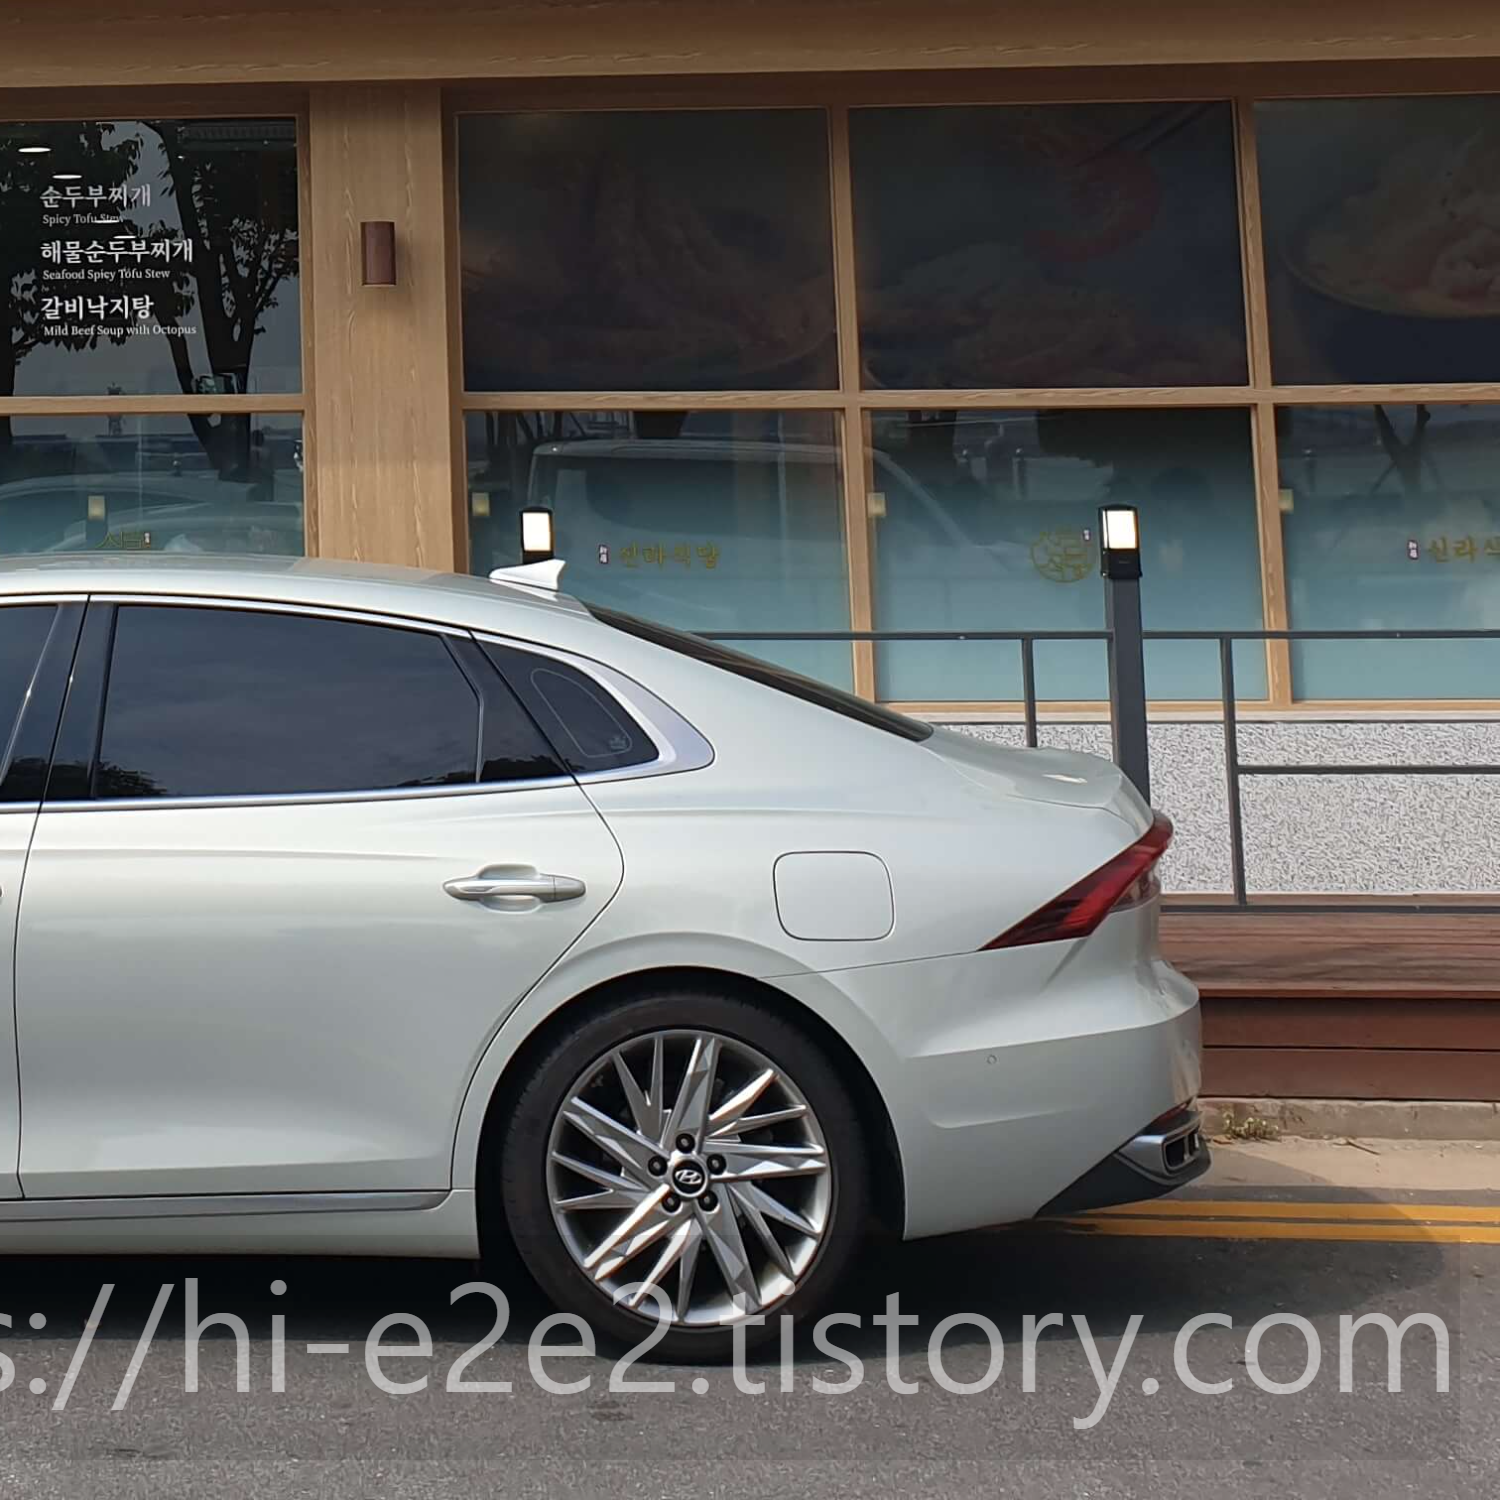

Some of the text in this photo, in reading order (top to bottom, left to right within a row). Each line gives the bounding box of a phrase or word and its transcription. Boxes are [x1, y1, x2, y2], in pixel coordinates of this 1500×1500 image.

[40, 184, 151, 209] 순두부찌개
[42, 214, 71, 227] Spicy
[73, 213, 97, 224] Tofu
[40, 238, 193, 265] 해물순두부찌개
[42, 267, 170, 282] Seafood Spicy Tofu Stew
[41, 294, 154, 320] 갈비낙지탕
[44, 324, 197, 338] Mild Beef Soup with Octopus
